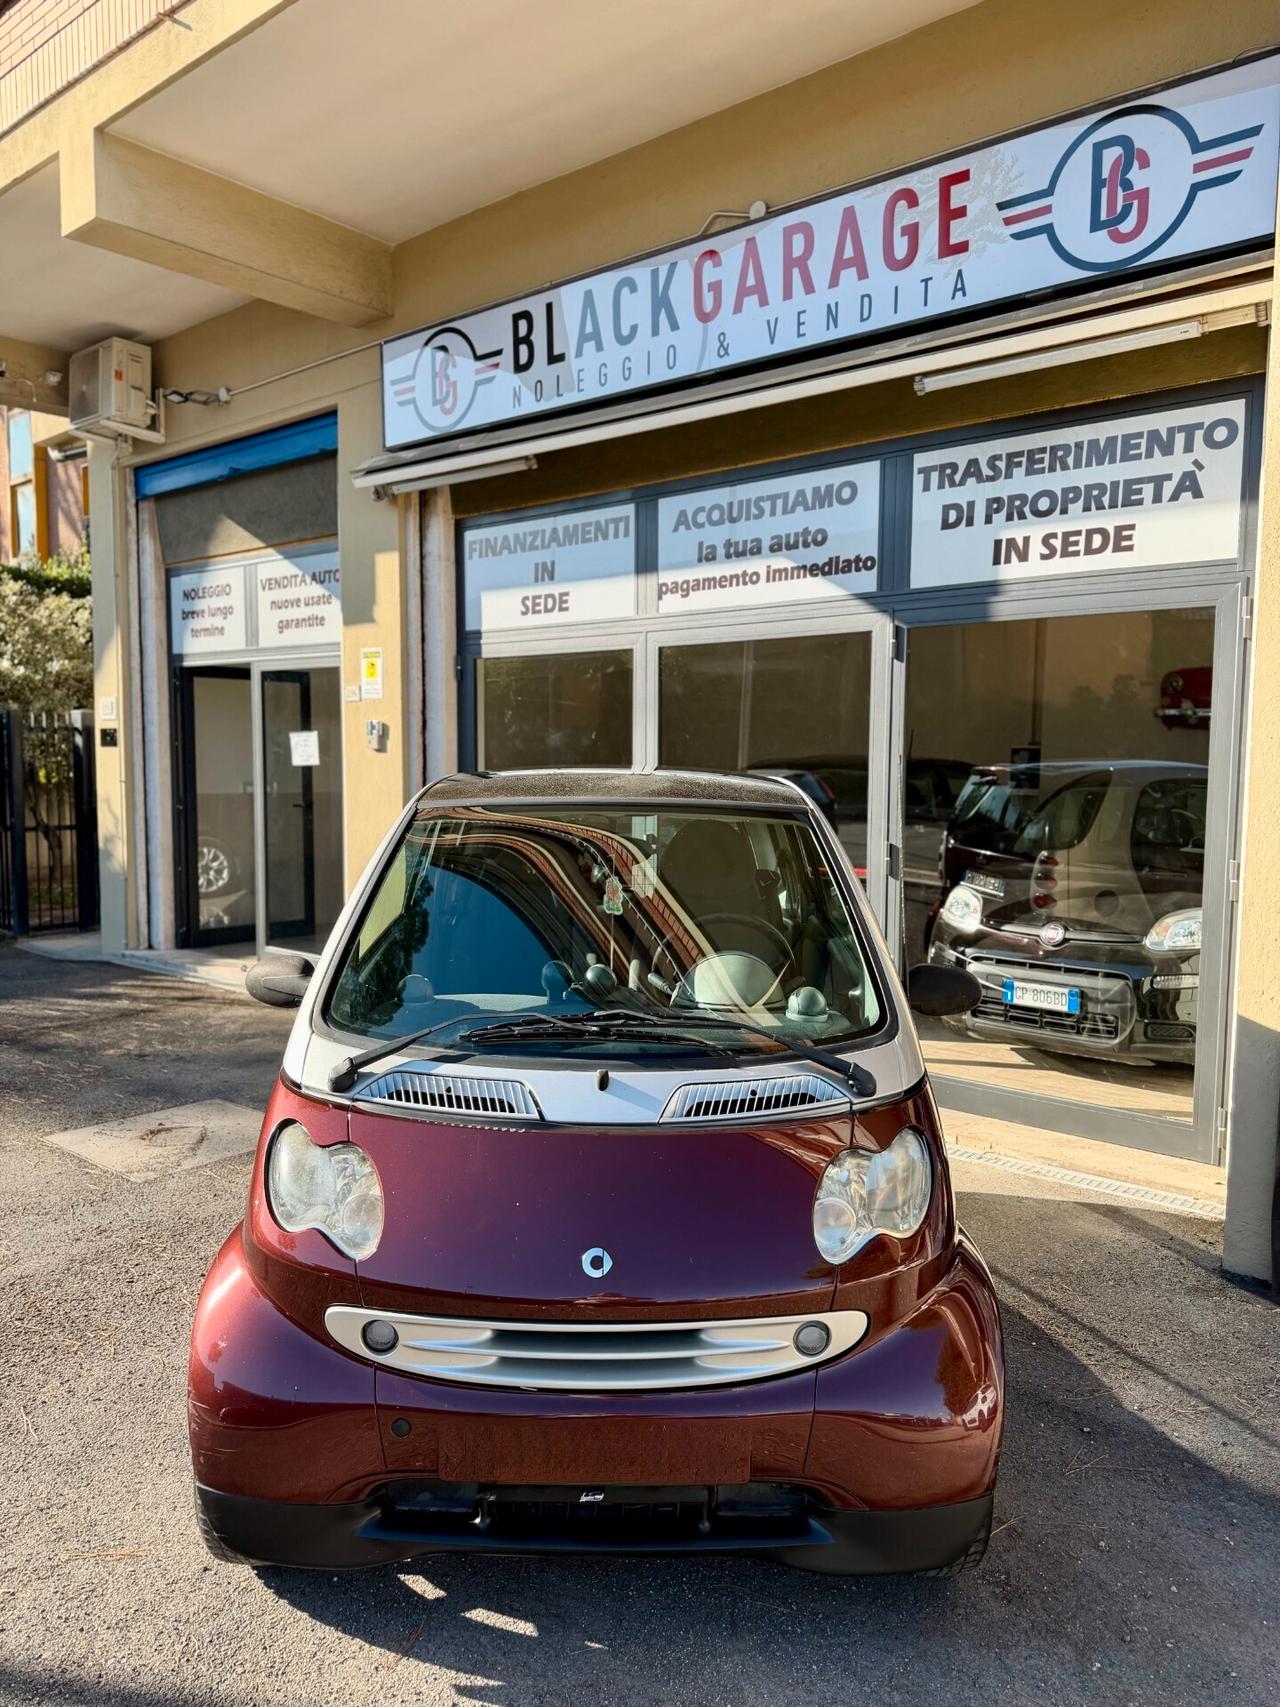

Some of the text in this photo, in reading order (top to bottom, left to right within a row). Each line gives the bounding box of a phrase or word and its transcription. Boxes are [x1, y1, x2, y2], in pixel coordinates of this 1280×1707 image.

[512, 268, 968, 409] NOLEGGIO & VENDITA
[917, 417, 1240, 493] TRASFERIMENTO
[672, 479, 859, 534] ACQUISTIAMO
[940, 458, 1206, 532] DI PROPRIETÀ
[467, 514, 631, 561] FINANZIAMENTI
[696, 526, 829, 564] la tua auto
[991, 523, 1137, 567] IN SEDE
[260, 572, 308, 592] VENDITA
[532, 560, 556, 584] IN
[657, 553, 877, 601] pagamento immediato
[182, 583, 232, 602] NOLEGGIO
[270, 591, 333, 612] nuove usate
[519, 591, 570, 617] SEDE
[181, 602, 234, 621] breve lungo
[277, 613, 326, 634] garantite
[190, 624, 225, 639] termine
